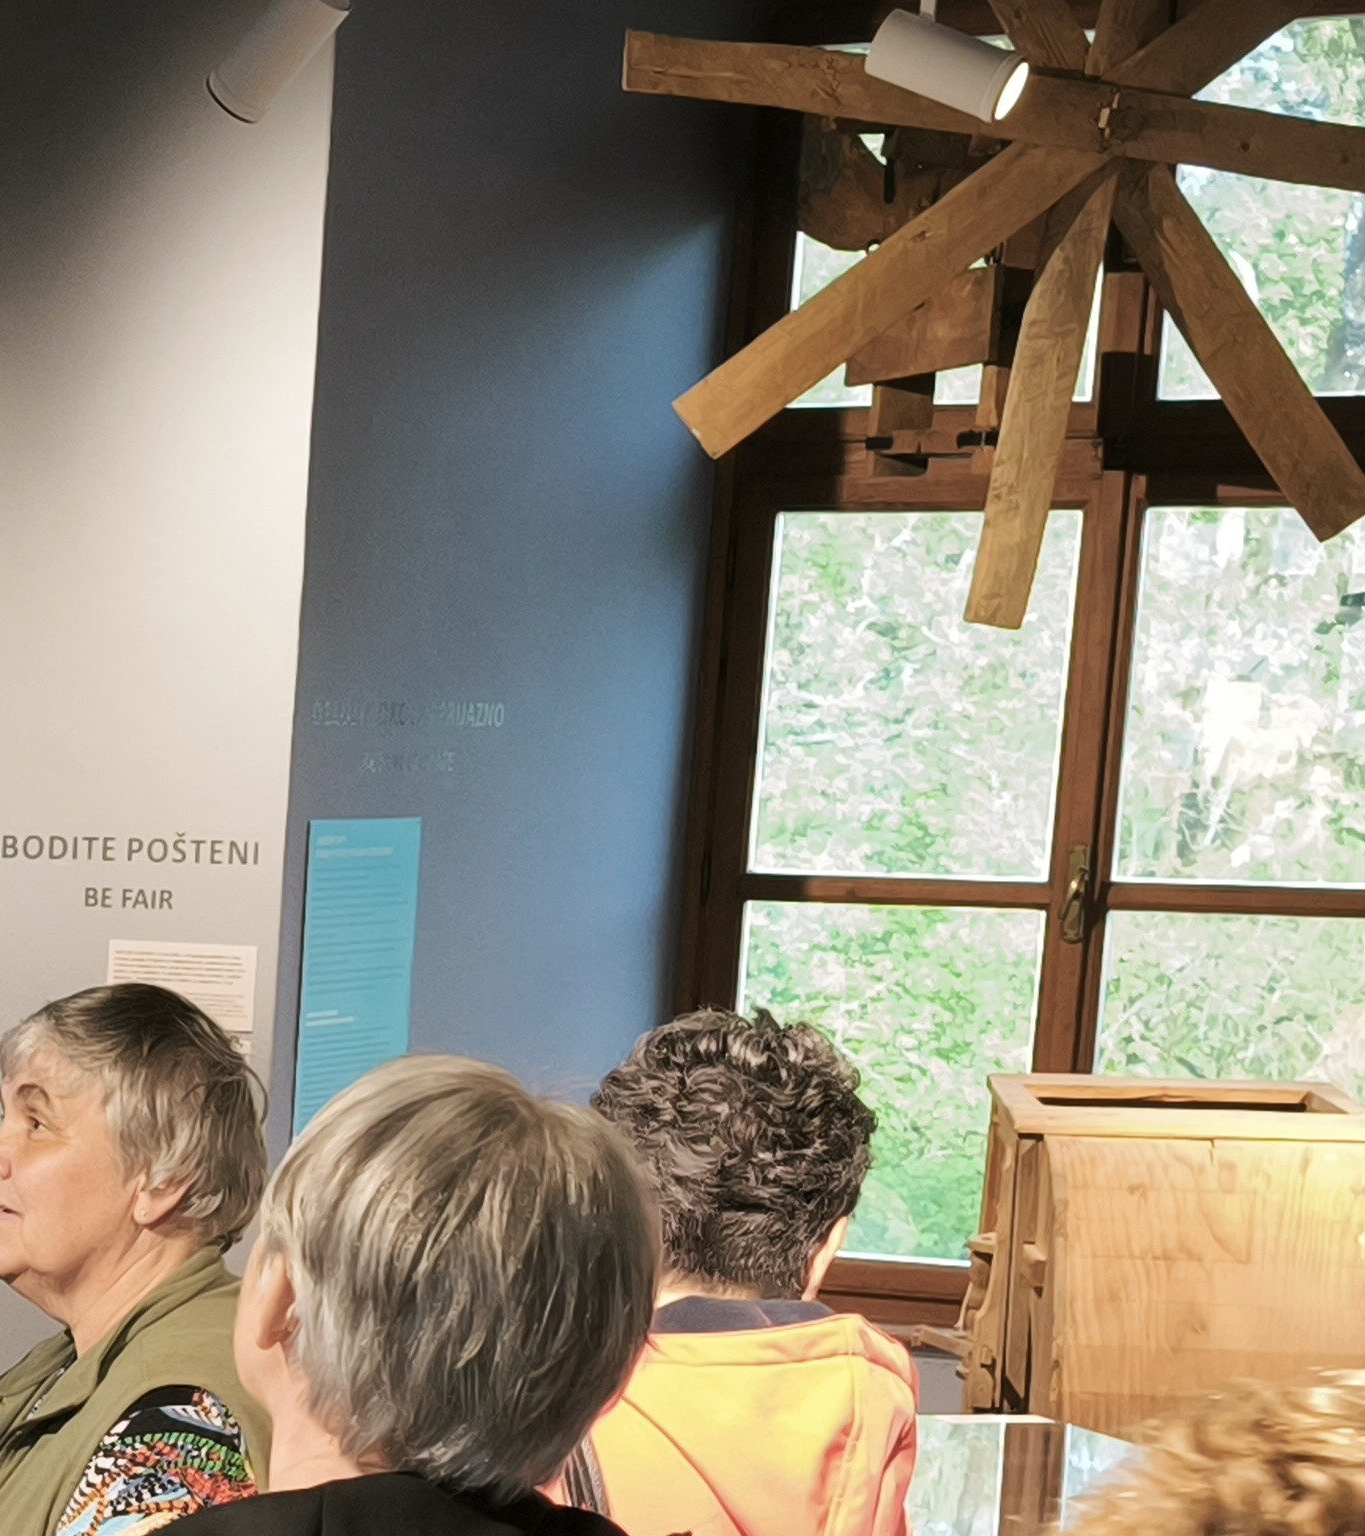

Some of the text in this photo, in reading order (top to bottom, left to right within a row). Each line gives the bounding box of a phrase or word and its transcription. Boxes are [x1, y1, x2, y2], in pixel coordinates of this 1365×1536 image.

[1, 832, 259, 865] BODITE POŠTENI
[84, 887, 173, 910] BE FAIR
